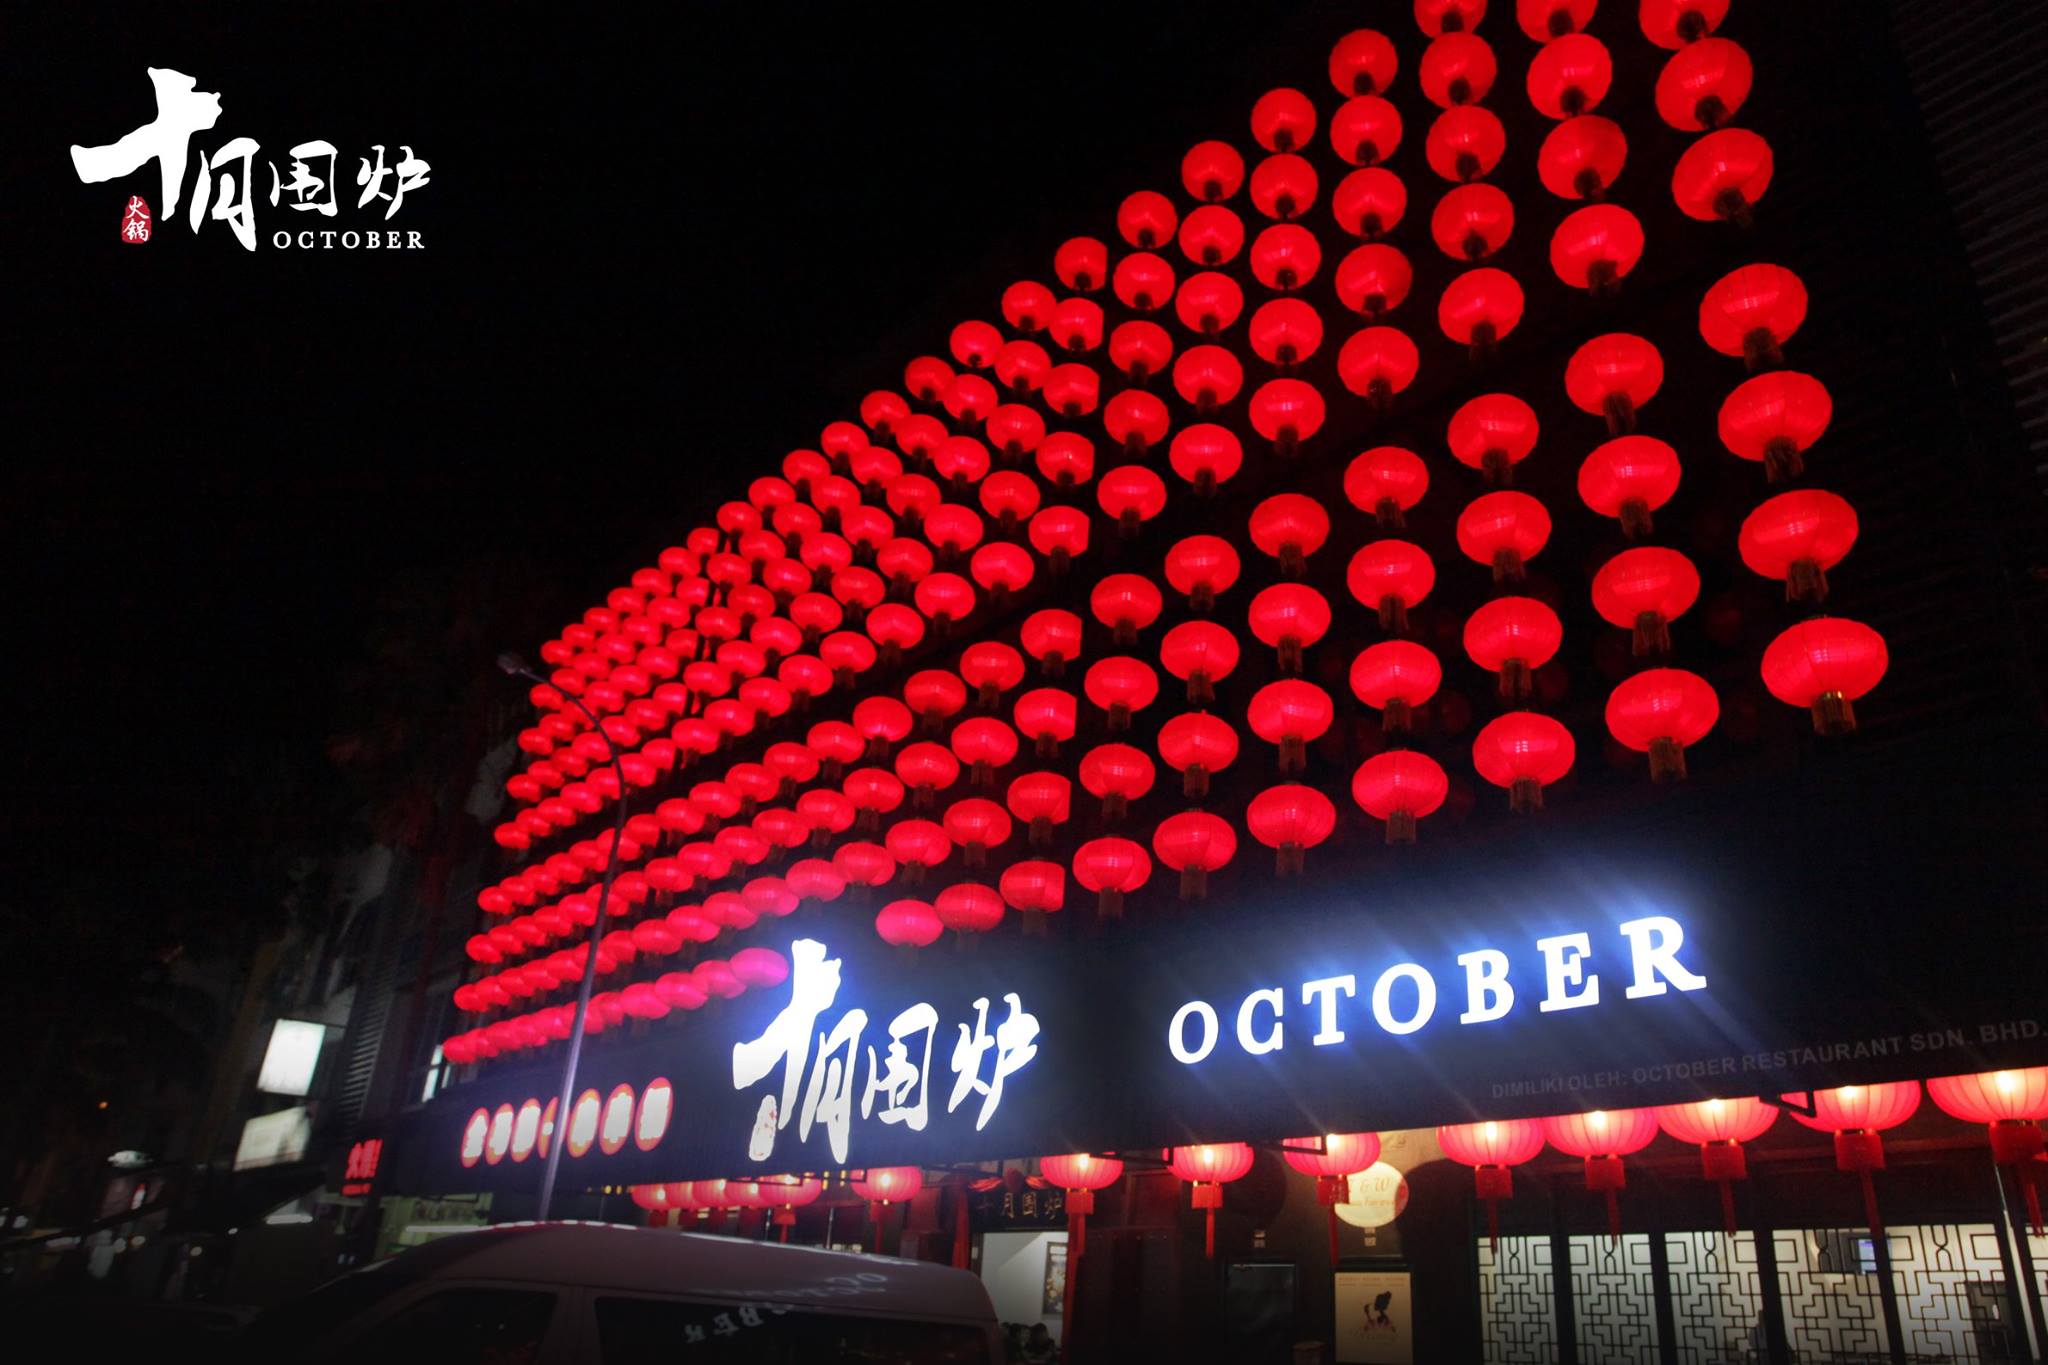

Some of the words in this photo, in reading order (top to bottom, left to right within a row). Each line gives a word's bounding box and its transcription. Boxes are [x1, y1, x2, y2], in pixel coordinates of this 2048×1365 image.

[1168, 915, 1707, 1064] OCTOBER
[1491, 1077, 1563, 1099] DIMILIKI
[1568, 1070, 1628, 1092] OLEH:
[1632, 1056, 1737, 1086] OCTOBER
[1742, 1037, 1902, 1072] RESTAURANT
[1910, 1029, 1973, 1051] SDN.
[1979, 1020, 2048, 1043] BHD.
